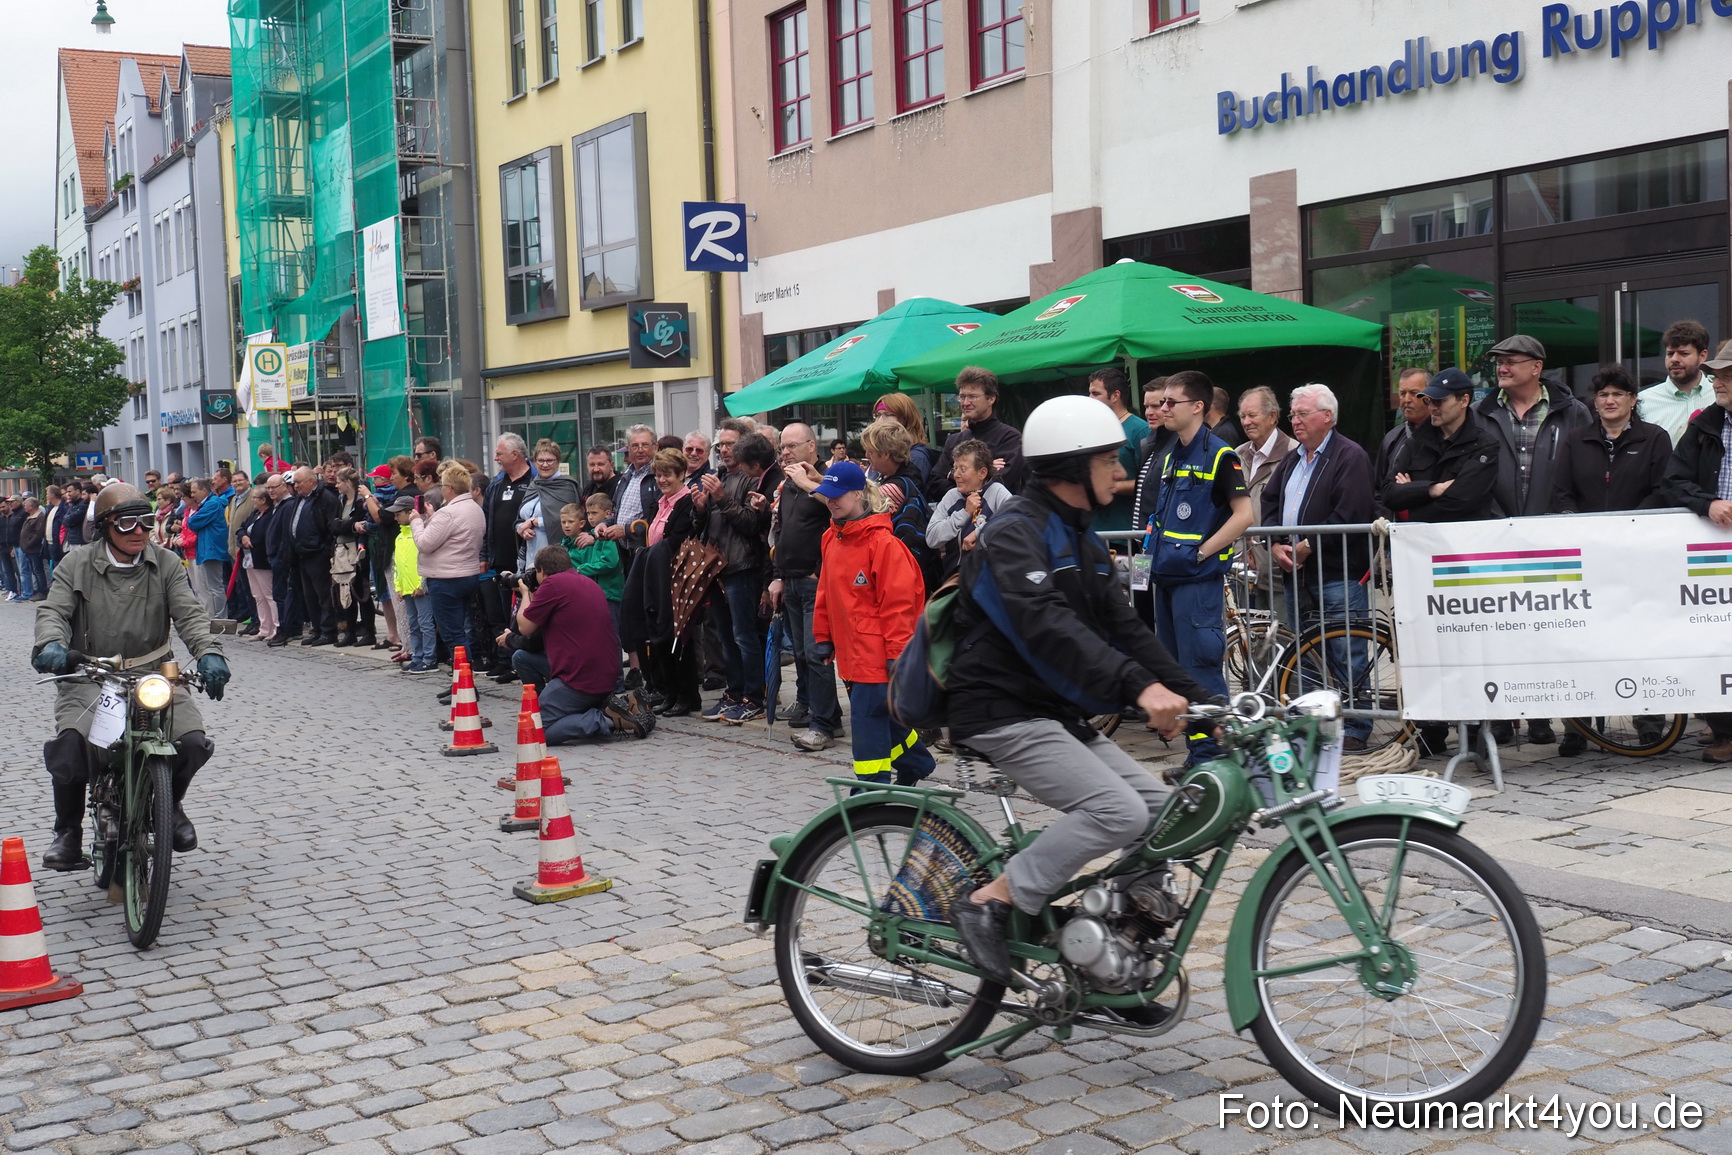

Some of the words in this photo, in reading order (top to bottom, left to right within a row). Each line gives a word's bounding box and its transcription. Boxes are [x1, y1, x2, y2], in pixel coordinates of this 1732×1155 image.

[1217, 30, 1524, 135] Buchhandlung
[754, 290, 774, 304] Unterer
[776, 285, 792, 299] Markt
[793, 283, 800, 296] 15
[1184, 304, 1267, 315] Neumarkter
[1182, 312, 1299, 325] Lammsbräu
[653, 320, 674, 347] G2
[1417, 327, 1432, 335] und
[967, 328, 1067, 351] Lammsbräu
[262, 354, 275, 370] H
[1426, 588, 1593, 616] NeuerMarkt
[1436, 622, 1489, 634] einkaufen
[1495, 619, 1527, 632] leben
[1533, 618, 1587, 632] genießen
[1503, 679, 1568, 692] Dammstraße
[1571, 679, 1577, 689] 1
[1642, 675, 1682, 687] Mo.-Sa.
[1504, 692, 1555, 704] Neumarkt
[1556, 692, 1563, 702] i.
[1564, 691, 1574, 703] d.
[1576, 690, 1597, 702] OPf.
[1642, 688, 1675, 699] 10-20
[1677, 687, 1697, 699] Uhr
[1376, 780, 1410, 797] SDL
